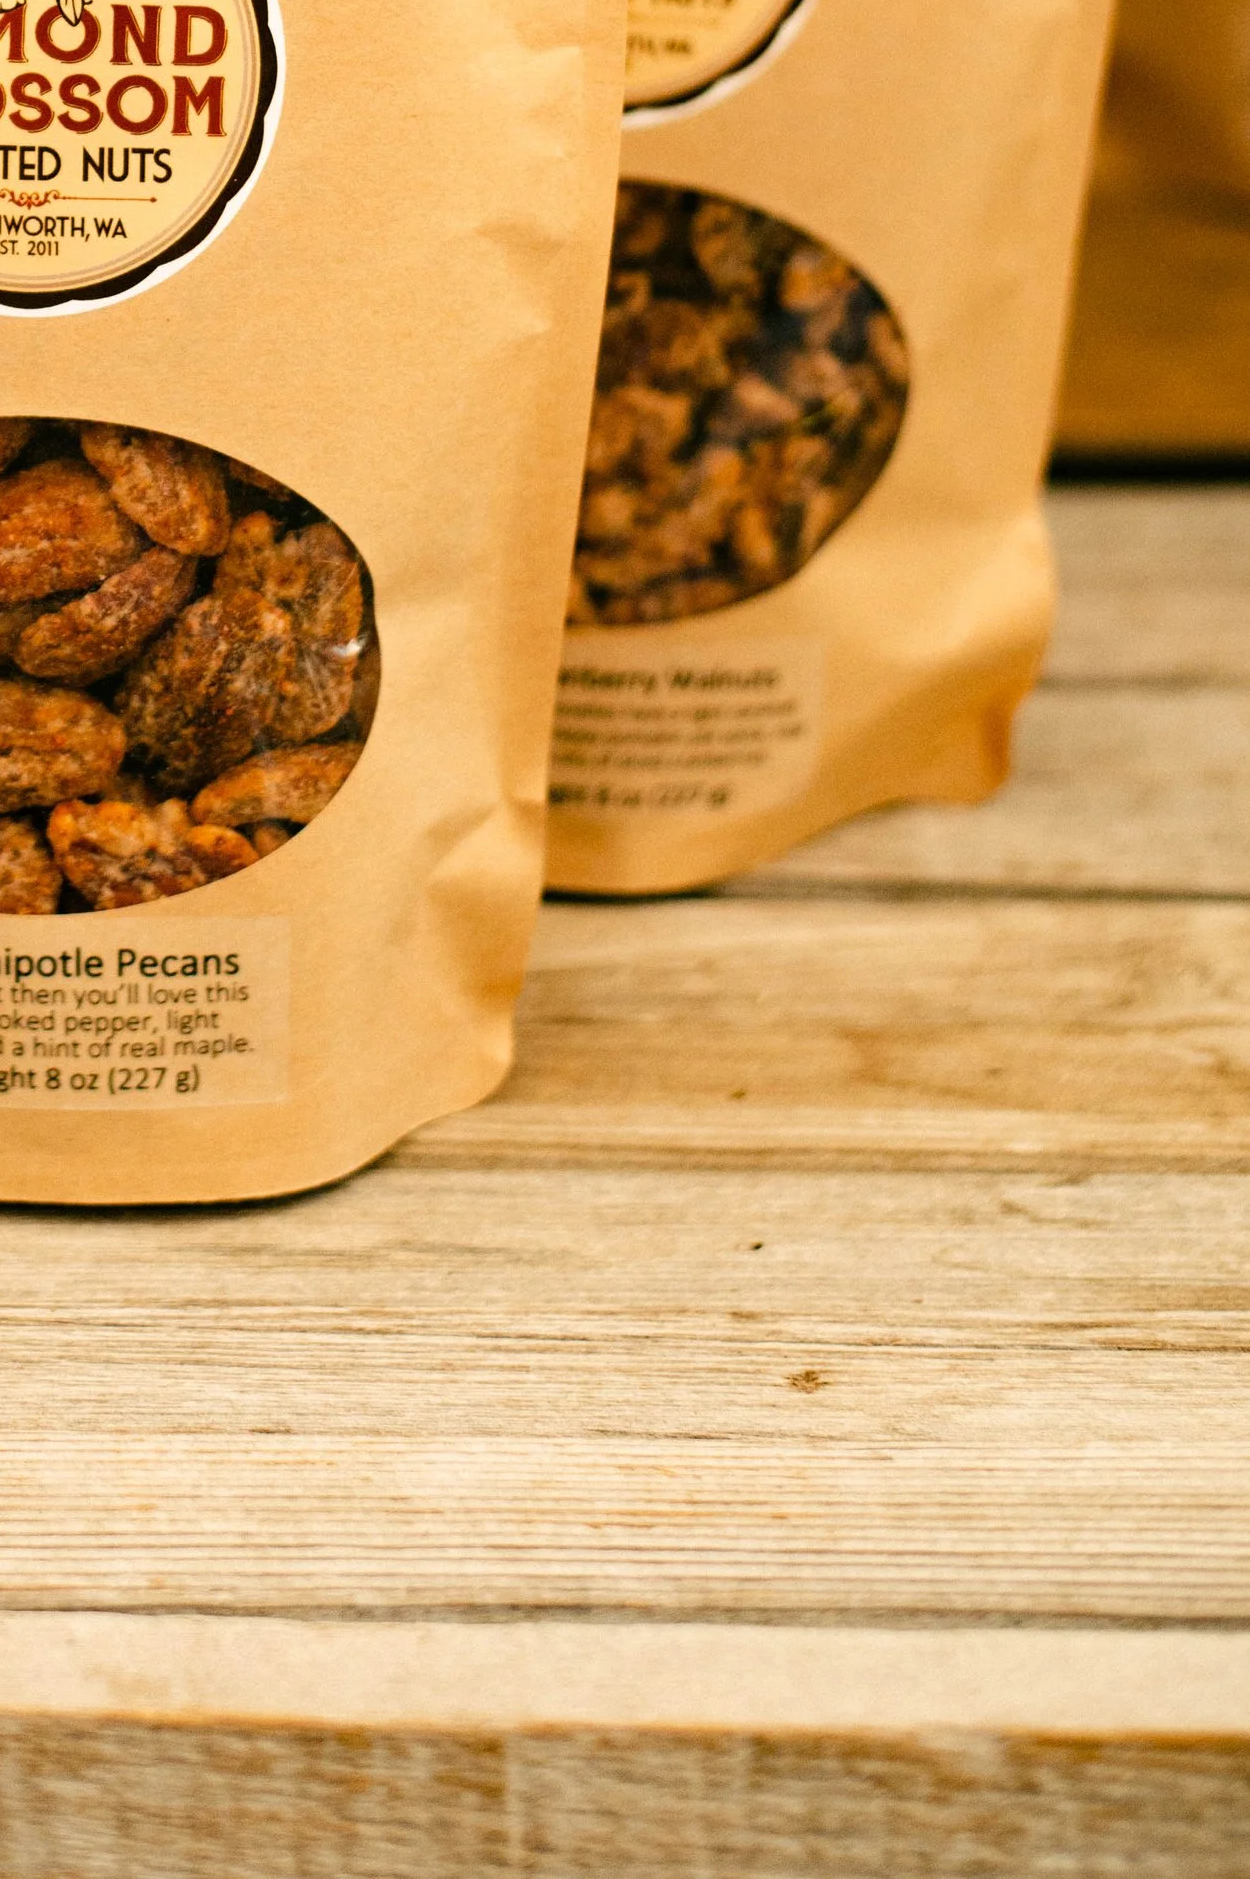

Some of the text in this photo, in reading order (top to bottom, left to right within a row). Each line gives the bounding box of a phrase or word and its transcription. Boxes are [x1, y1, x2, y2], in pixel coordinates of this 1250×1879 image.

[82, 146, 173, 184] NUTS
[93, 217, 128, 239] WA
[27, 240, 60, 257] 2011
[117, 948, 240, 978] Pecans
[10, 982, 66, 1006] then
[148, 982, 198, 1005] love
[205, 980, 250, 1003] this
[64, 1014, 159, 1038] pepper,
[166, 1008, 221, 1035] light
[10, 1040, 25, 1058] a
[32, 1036, 81, 1059] hint
[87, 1033, 116, 1059] of
[118, 1036, 166, 1059] real
[172, 1033, 256, 1060] maple.
[44, 1067, 62, 1091] 8
[69, 1071, 100, 1092] oz
[107, 1066, 167, 1096] (227
[174, 1063, 201, 1094] g)
